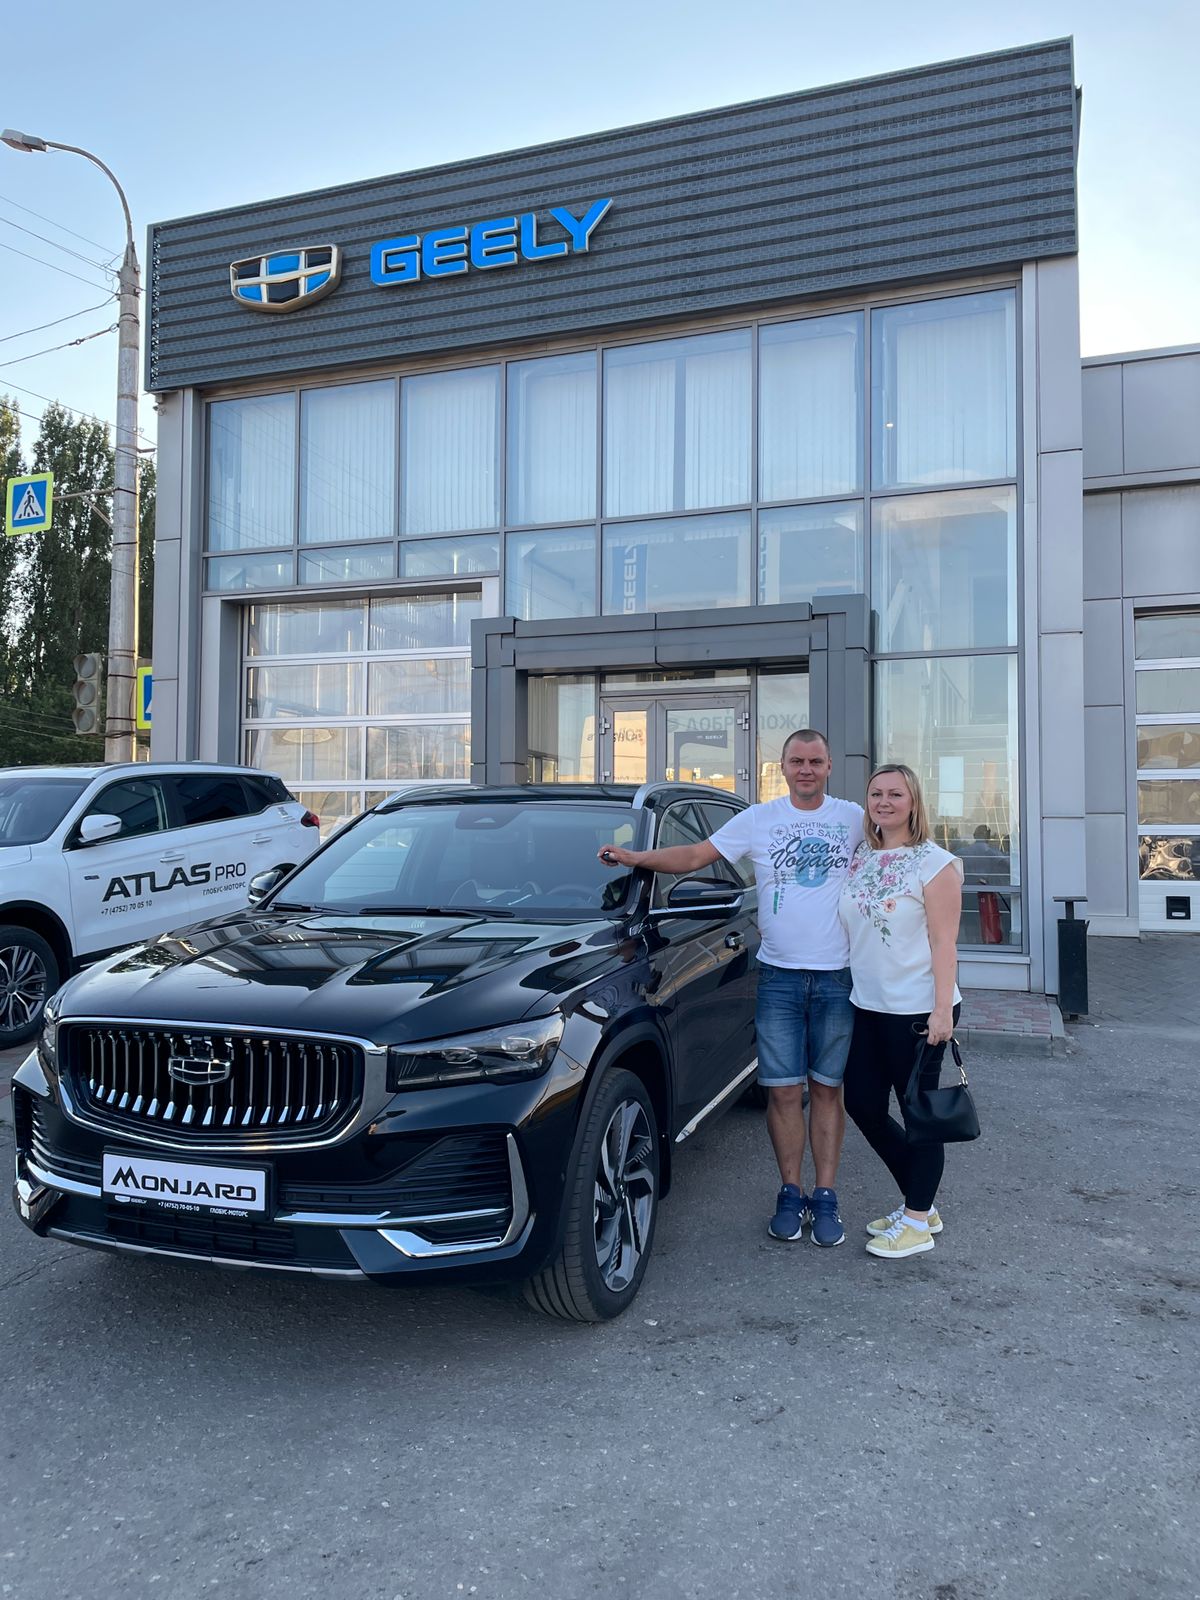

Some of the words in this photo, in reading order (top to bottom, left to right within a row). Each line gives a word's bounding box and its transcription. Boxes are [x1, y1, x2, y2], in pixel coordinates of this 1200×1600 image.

[370, 198, 613, 288] GEELY
[767, 828, 814, 855] ATLANTIC
[817, 829, 851, 855] SAILING
[785, 836, 842, 855] Ocean
[769, 848, 849, 876] Voyager
[102, 862, 212, 902] ATLAS
[215, 862, 246, 881] PRO
[109, 904, 128, 915] (4752)
[111, 1166, 257, 1202] MONJARO
[164, 1202, 179, 1210] (4752)
[179, 1204, 200, 1212] 70-05-10
